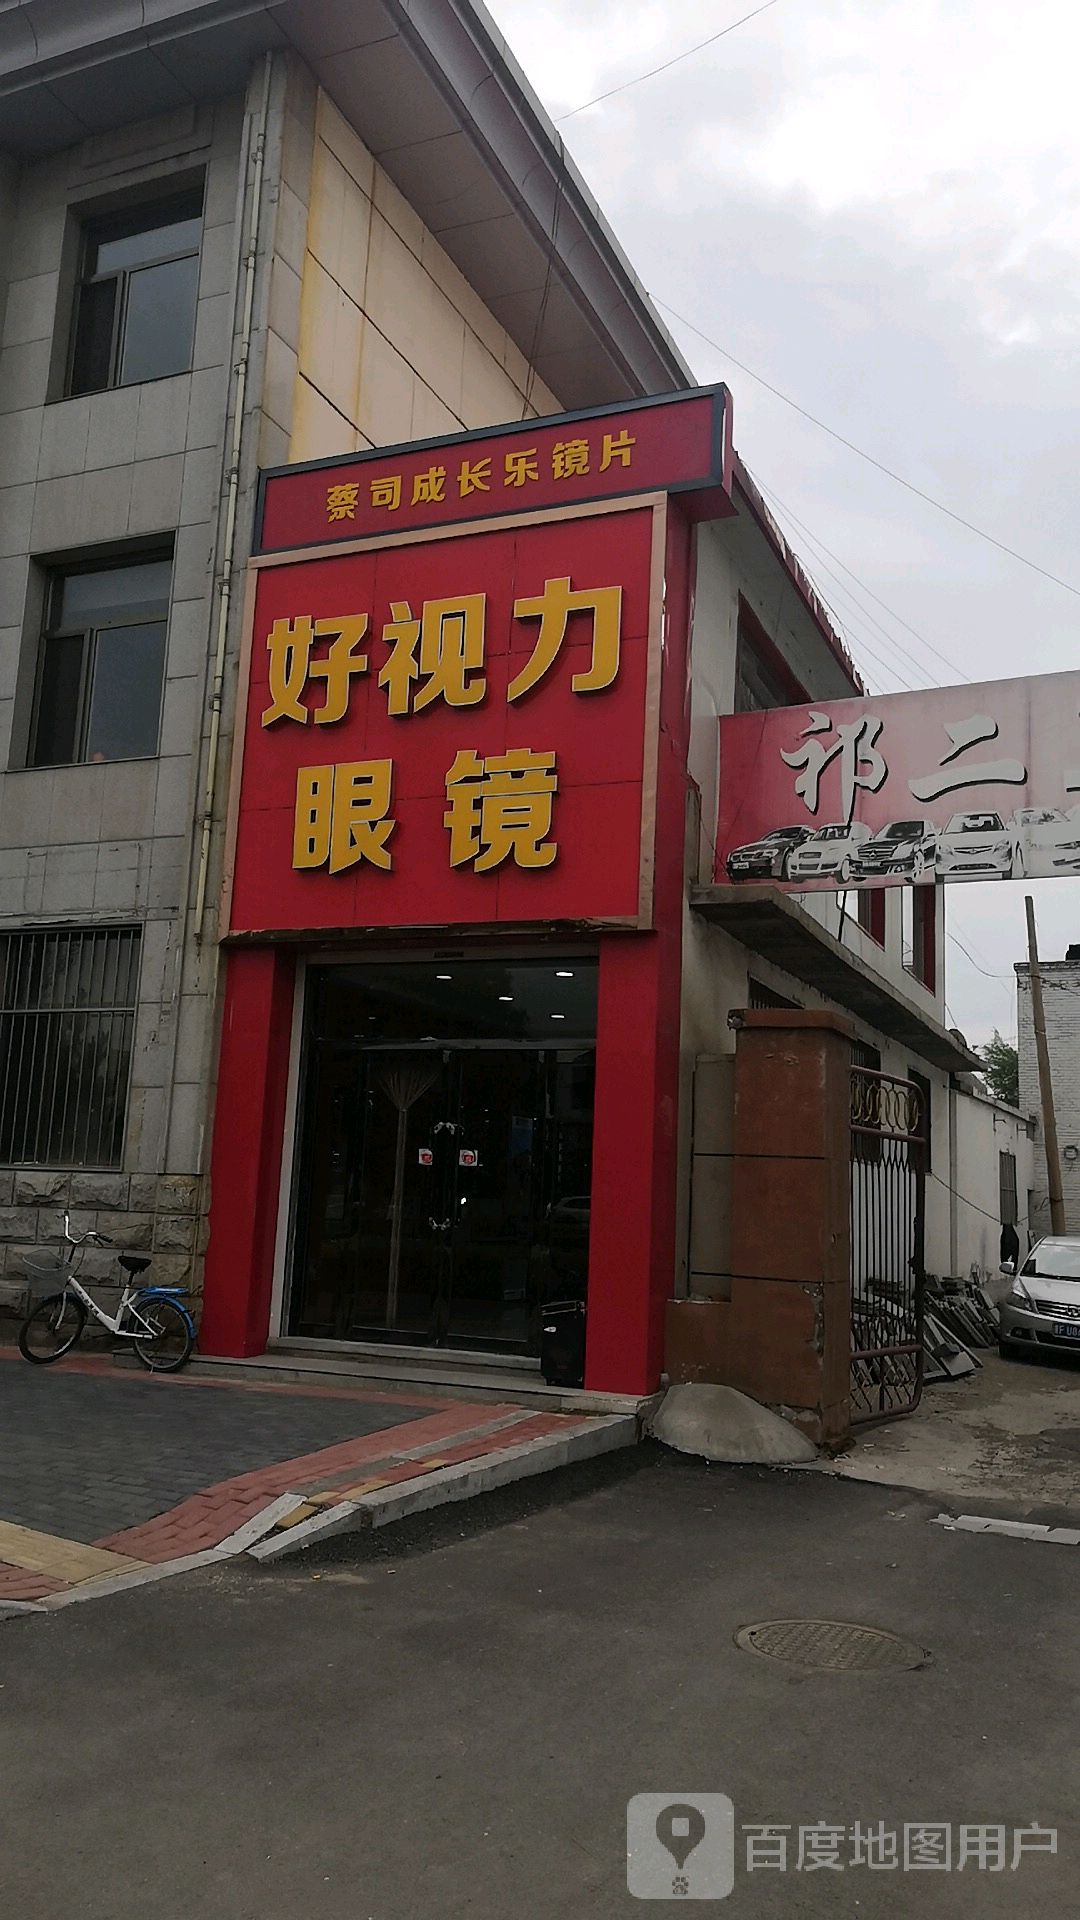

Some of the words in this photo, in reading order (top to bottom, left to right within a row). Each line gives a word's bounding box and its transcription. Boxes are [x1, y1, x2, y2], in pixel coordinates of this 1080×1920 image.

[326, 430, 636, 523] 蔡司成长乐镜片
[261, 576, 622, 728] 好视力
[292, 748, 559, 875] 眼镜
[780, 711, 1080, 825] 祁二
